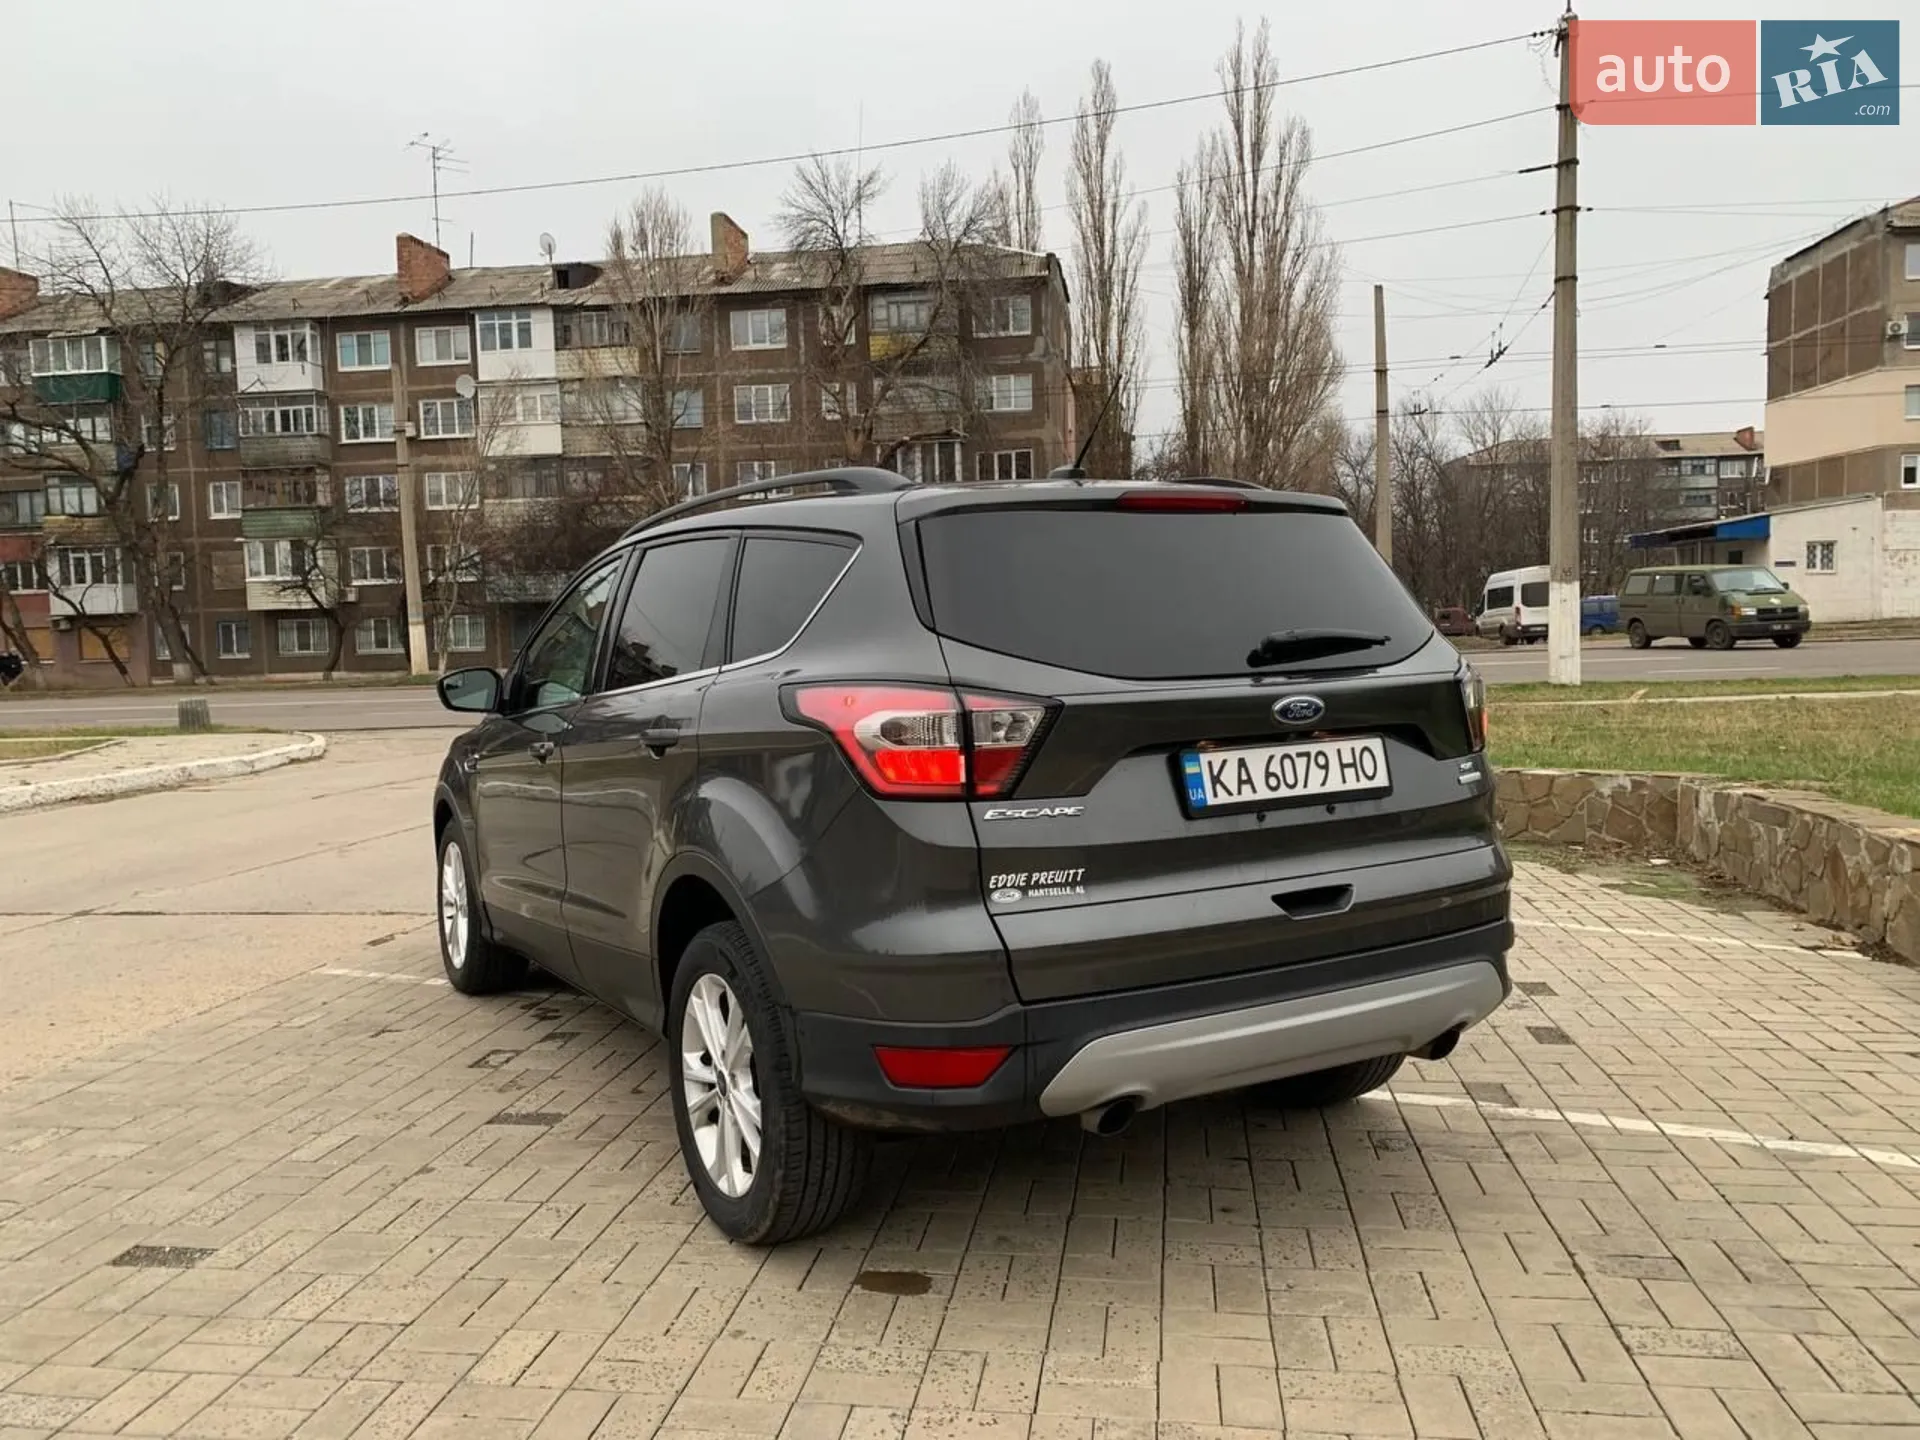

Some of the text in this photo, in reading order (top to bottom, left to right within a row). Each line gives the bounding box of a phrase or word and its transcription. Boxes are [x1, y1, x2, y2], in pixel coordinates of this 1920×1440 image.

[1207, 745, 1378, 799] KA 6079 HO
[1189, 787, 1205, 800] UA
[983, 806, 1084, 820] ESCAPE
[989, 873, 1028, 889] EDDIE
